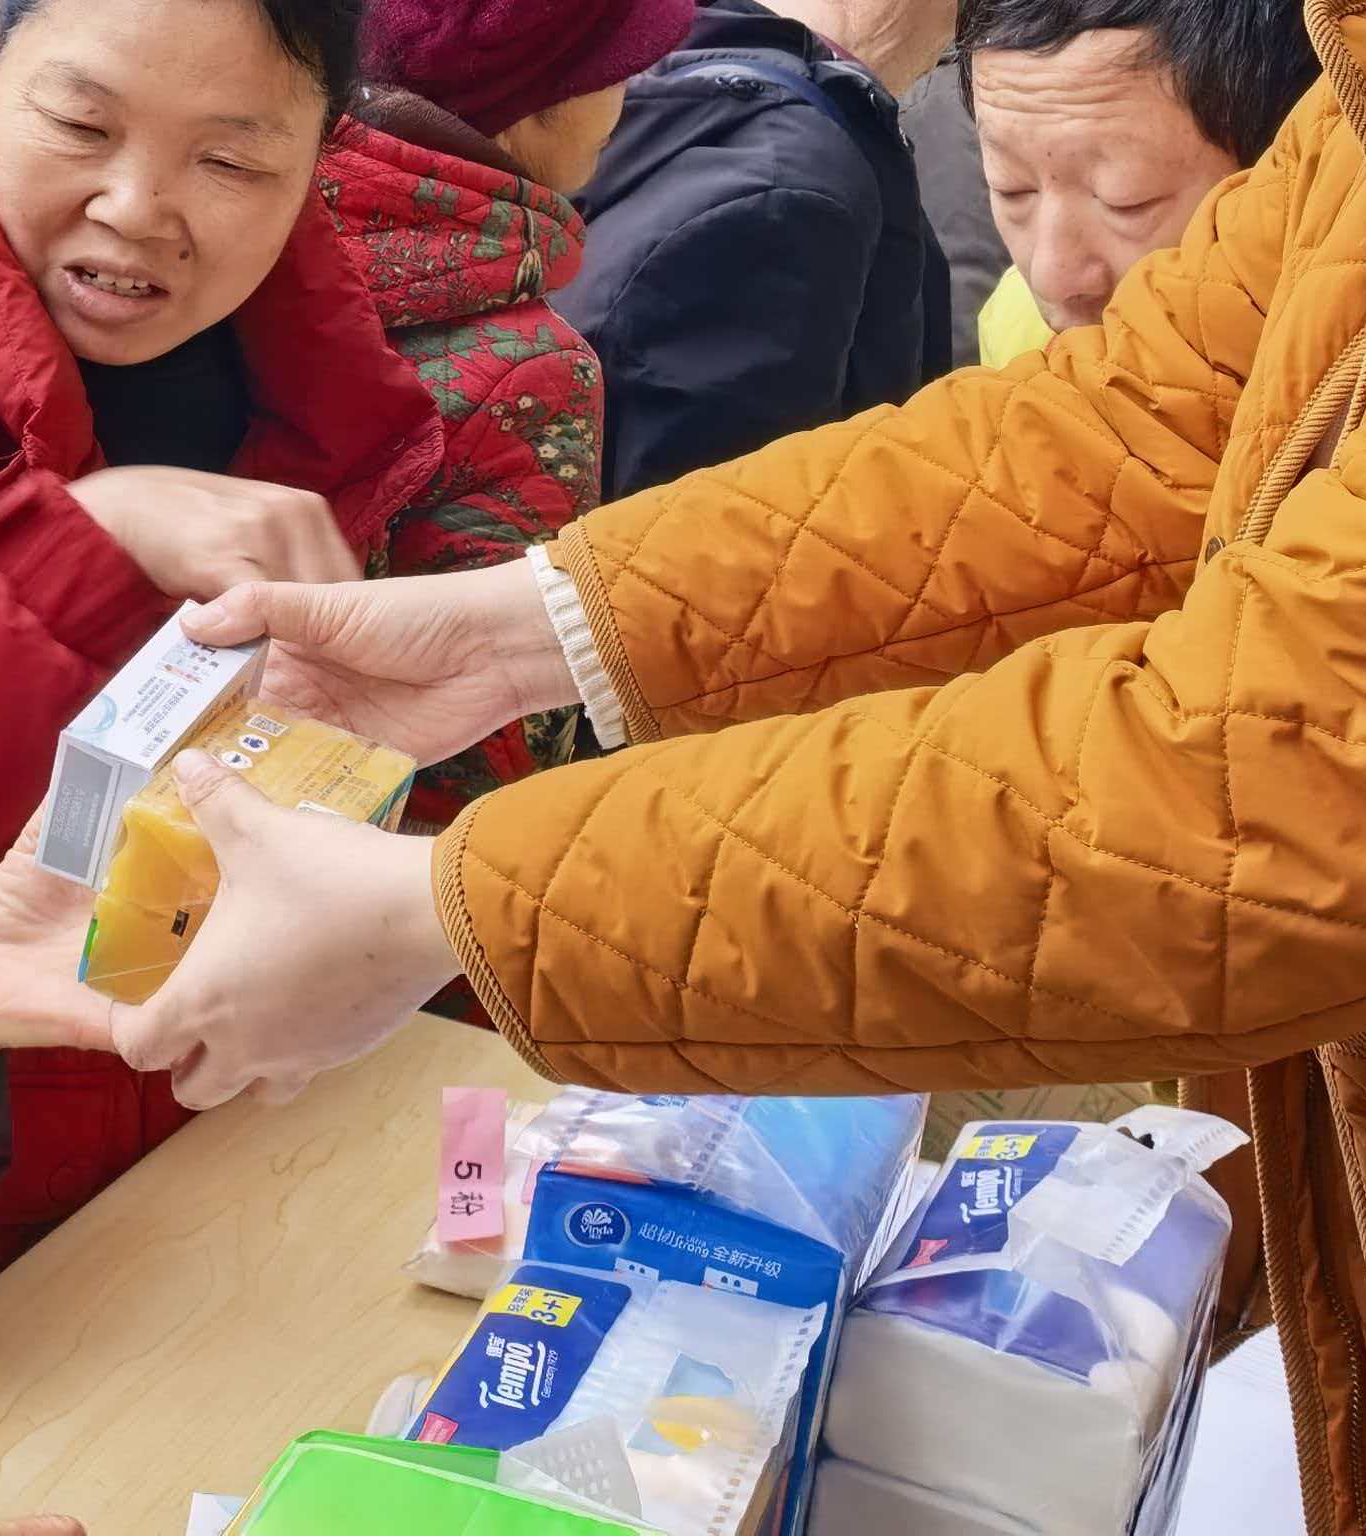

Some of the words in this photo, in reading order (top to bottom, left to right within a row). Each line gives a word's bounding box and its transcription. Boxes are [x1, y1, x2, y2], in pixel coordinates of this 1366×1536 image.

[959, 1167, 1004, 1224] Tempo
[579, 1222, 614, 1236] Vinda
[710, 1245, 782, 1280] 全新升级
[530, 1292, 569, 1325] 3+1
[479, 1341, 535, 1410] Tempo
